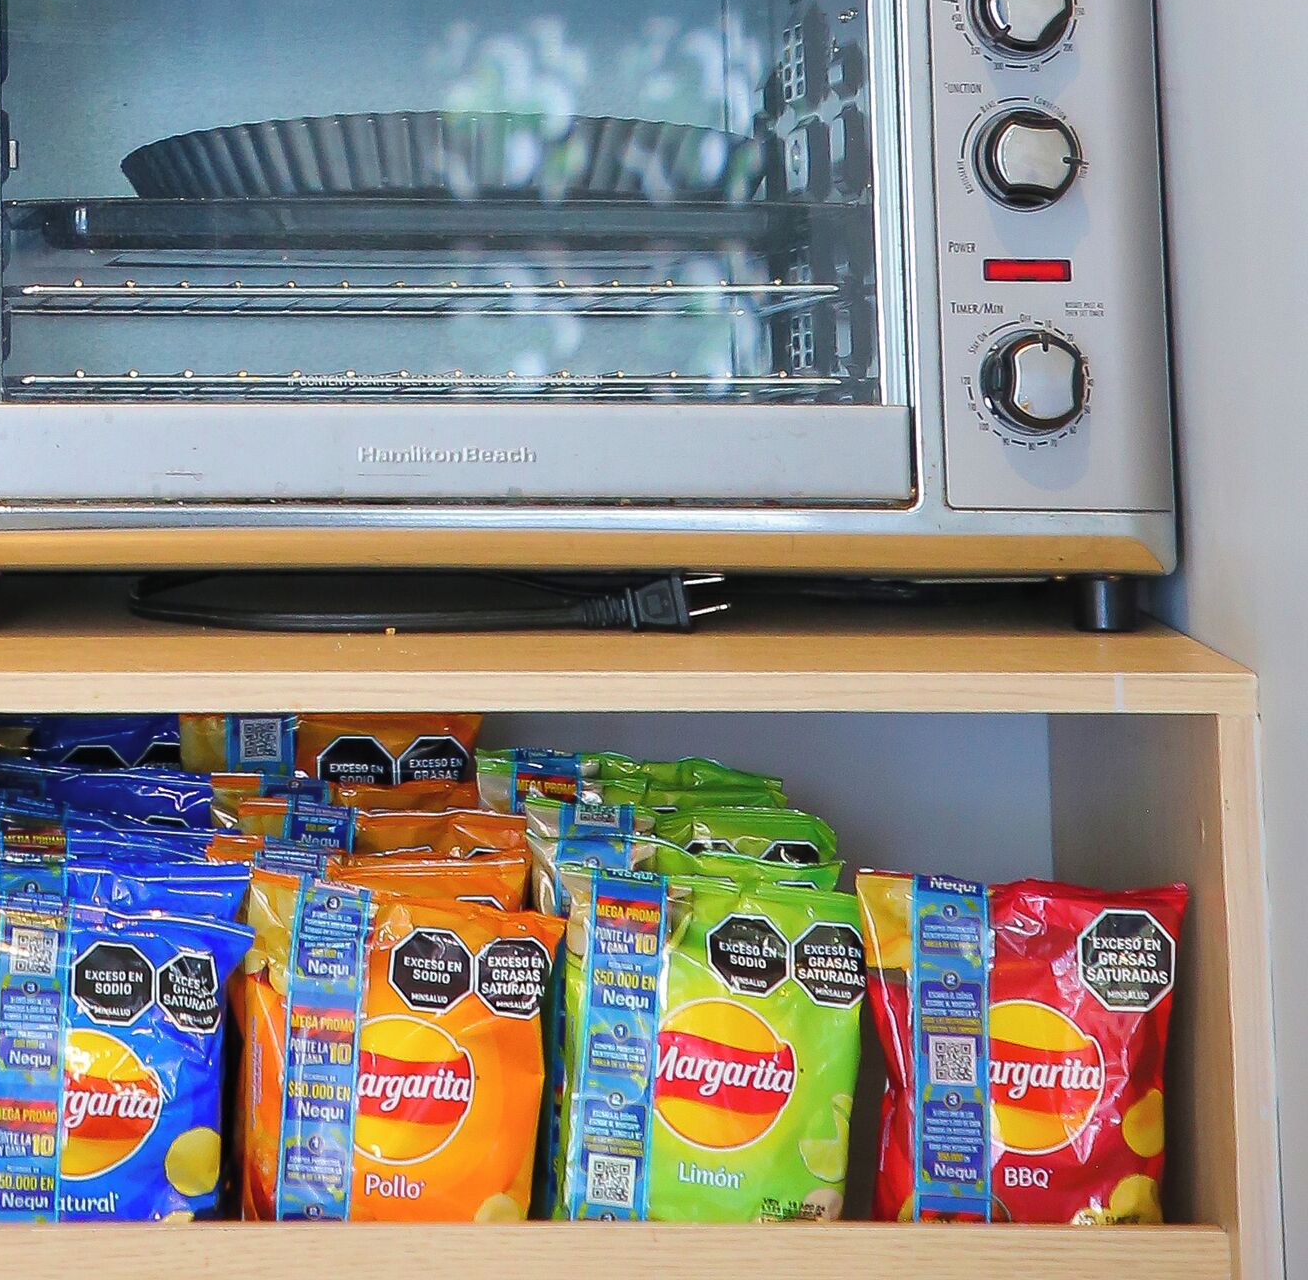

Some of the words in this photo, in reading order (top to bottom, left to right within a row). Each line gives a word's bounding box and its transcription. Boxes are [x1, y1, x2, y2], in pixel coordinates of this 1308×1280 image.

[948, 242, 976, 253] POWER
[597, 904, 626, 918] MEGA
[628, 906, 660, 922] PROMO
[719, 941, 761, 956] EXCESO
[763, 946, 777, 958] EN
[804, 944, 846, 956] EXCESO
[849, 946, 862, 958] EN
[1093, 937, 1141, 951] EXCESO
[1144, 939, 1161, 951] EN
[308, 957, 349, 975] Nequi
[404, 956, 445, 970] EXCESO
[447, 961, 462, 972] EN
[730, 955, 767, 970] SODIO
[809, 957, 858, 971] GRASAS
[1098, 952, 1157, 967] GRASAS
[85, 970, 126, 981] EXCESO
[129, 971, 143, 982] EN
[413, 969, 450, 983] SODIO
[594, 967, 640, 987] $50.000
[642, 975, 655, 990] EN
[798, 969, 866, 987] SATURADAS
[1087, 967, 1168, 984] SATURADAS
[95, 983, 132, 995] SODIO
[603, 988, 649, 1010] Nequi
[9, 1050, 51, 1066] Nequi
[990, 1058, 1102, 1099] argarita
[359, 1070, 470, 1112] argarita
[65, 1089, 158, 1128] rgarita
[678, 1161, 740, 1189] Limón
[935, 1163, 977, 1180] Nequi
[1005, 1167, 1049, 1189] BBQ
[40, 1176, 54, 1190] EN
[365, 1174, 421, 1198] Pollo
[58, 1192, 115, 1212] atural
